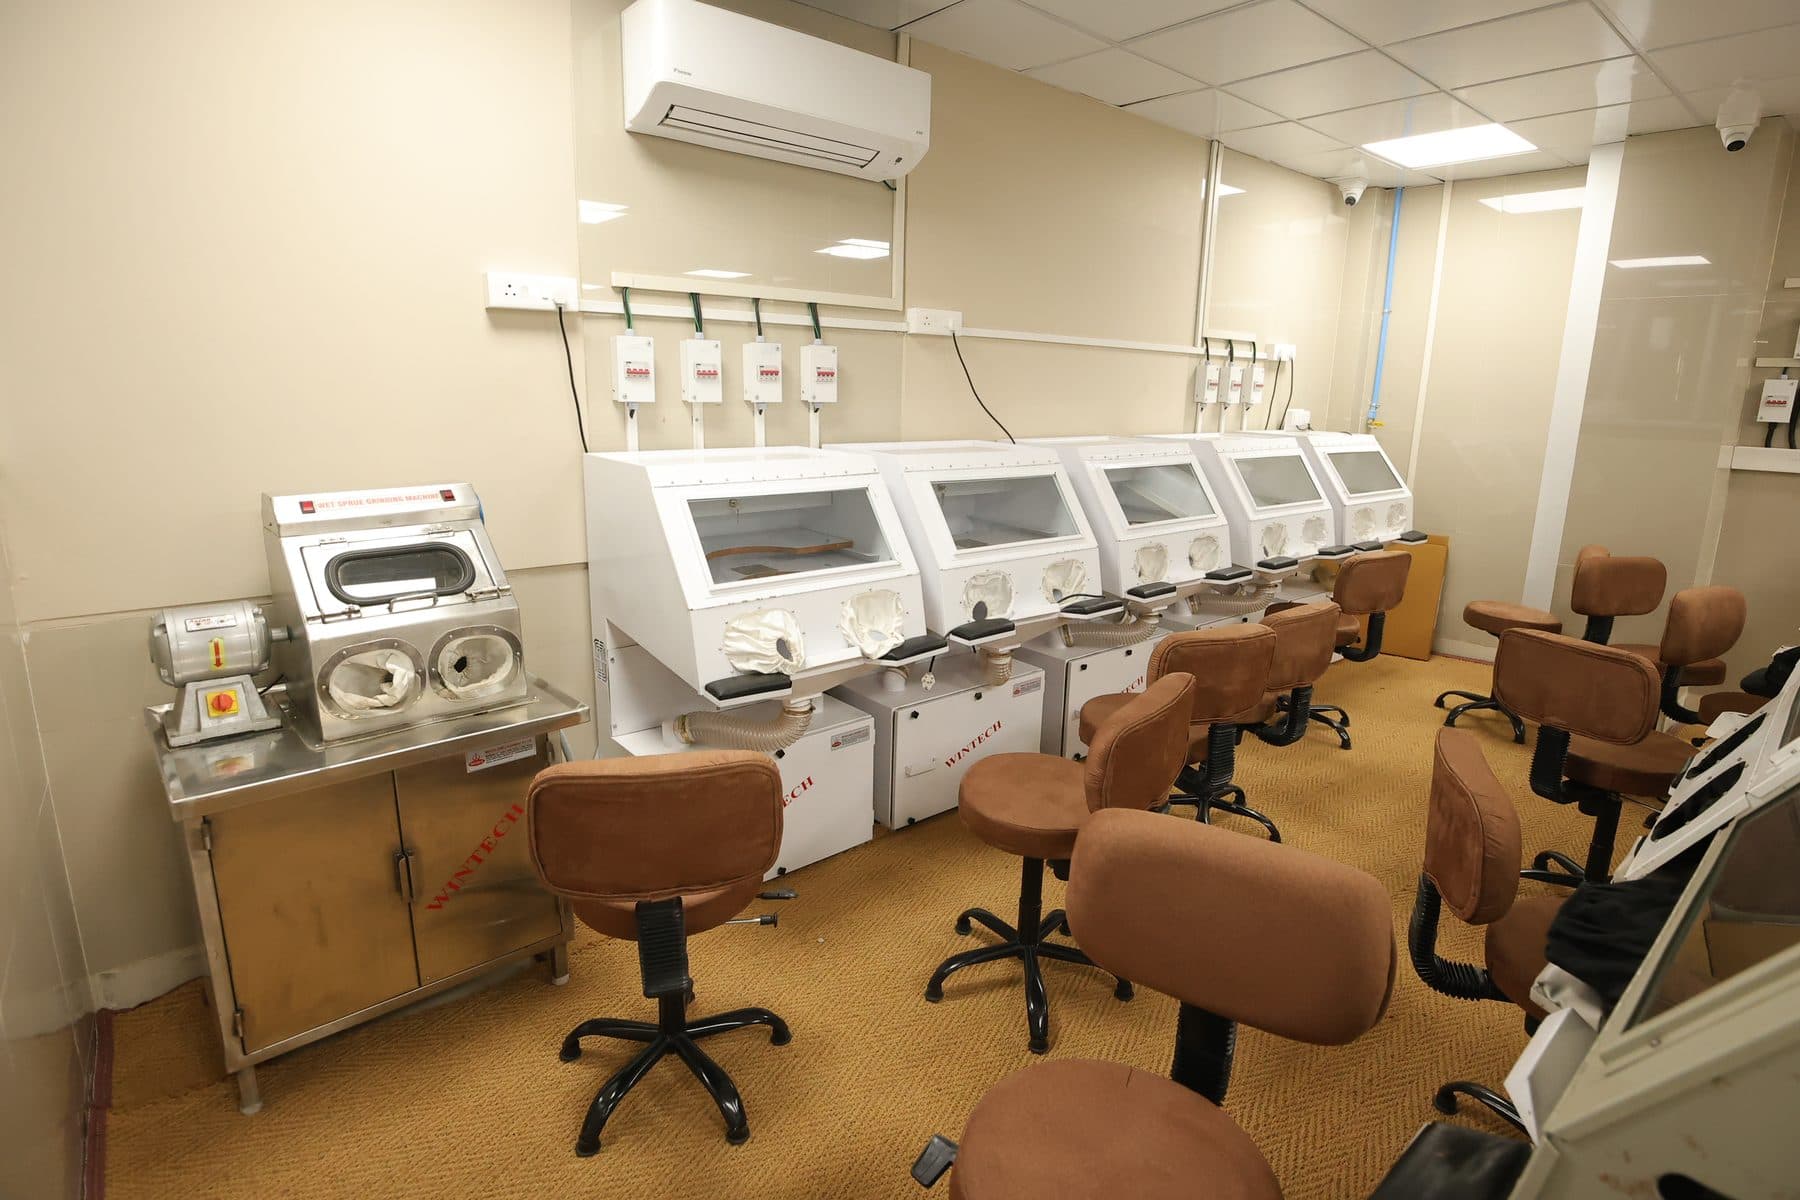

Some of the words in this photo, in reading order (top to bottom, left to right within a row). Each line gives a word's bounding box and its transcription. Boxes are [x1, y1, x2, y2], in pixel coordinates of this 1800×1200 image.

[317, 501, 335, 509] WET
[366, 495, 404, 505] GRINDING
[405, 493, 439, 502] MACHINE
[945, 720, 1002, 768] WINTECH
[425, 804, 524, 911] WINTECH
